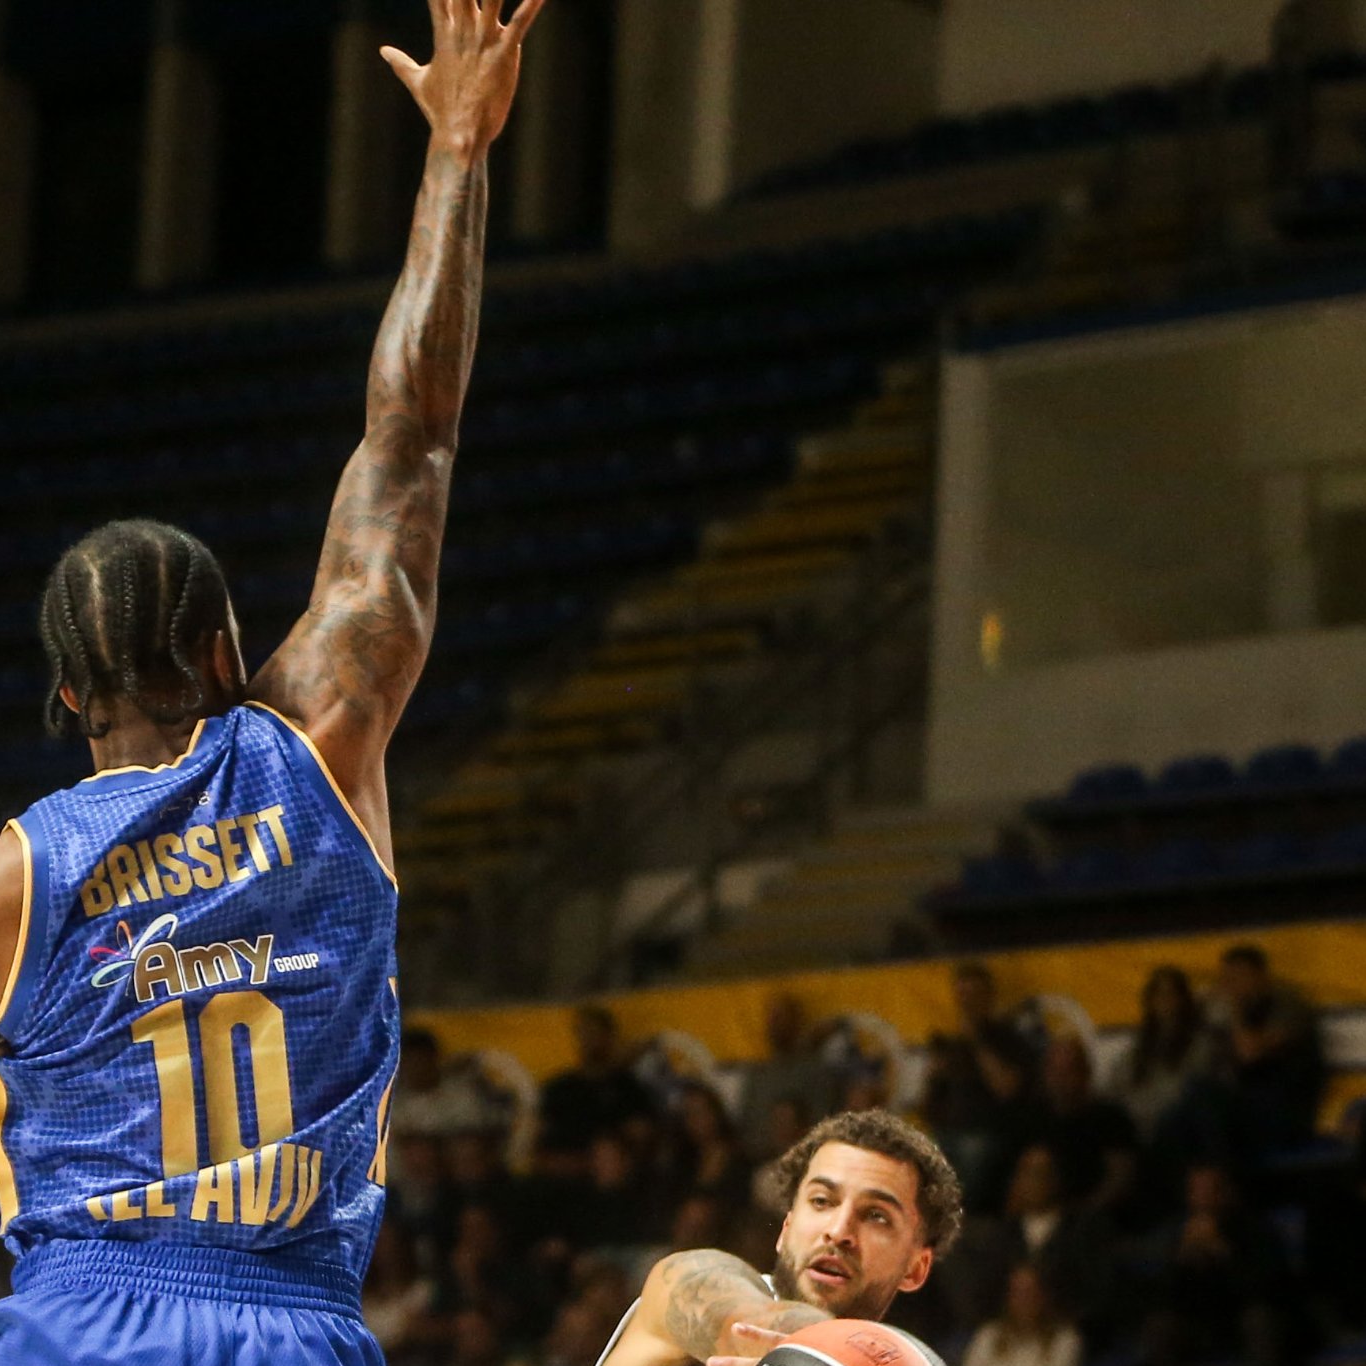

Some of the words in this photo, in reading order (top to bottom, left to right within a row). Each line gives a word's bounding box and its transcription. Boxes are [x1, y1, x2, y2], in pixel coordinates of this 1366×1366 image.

[79, 804, 293, 917] BRISSETT
[134, 934, 274, 1003] Amy
[273, 953, 319, 973] GROUP
[131, 990, 294, 1178] 10
